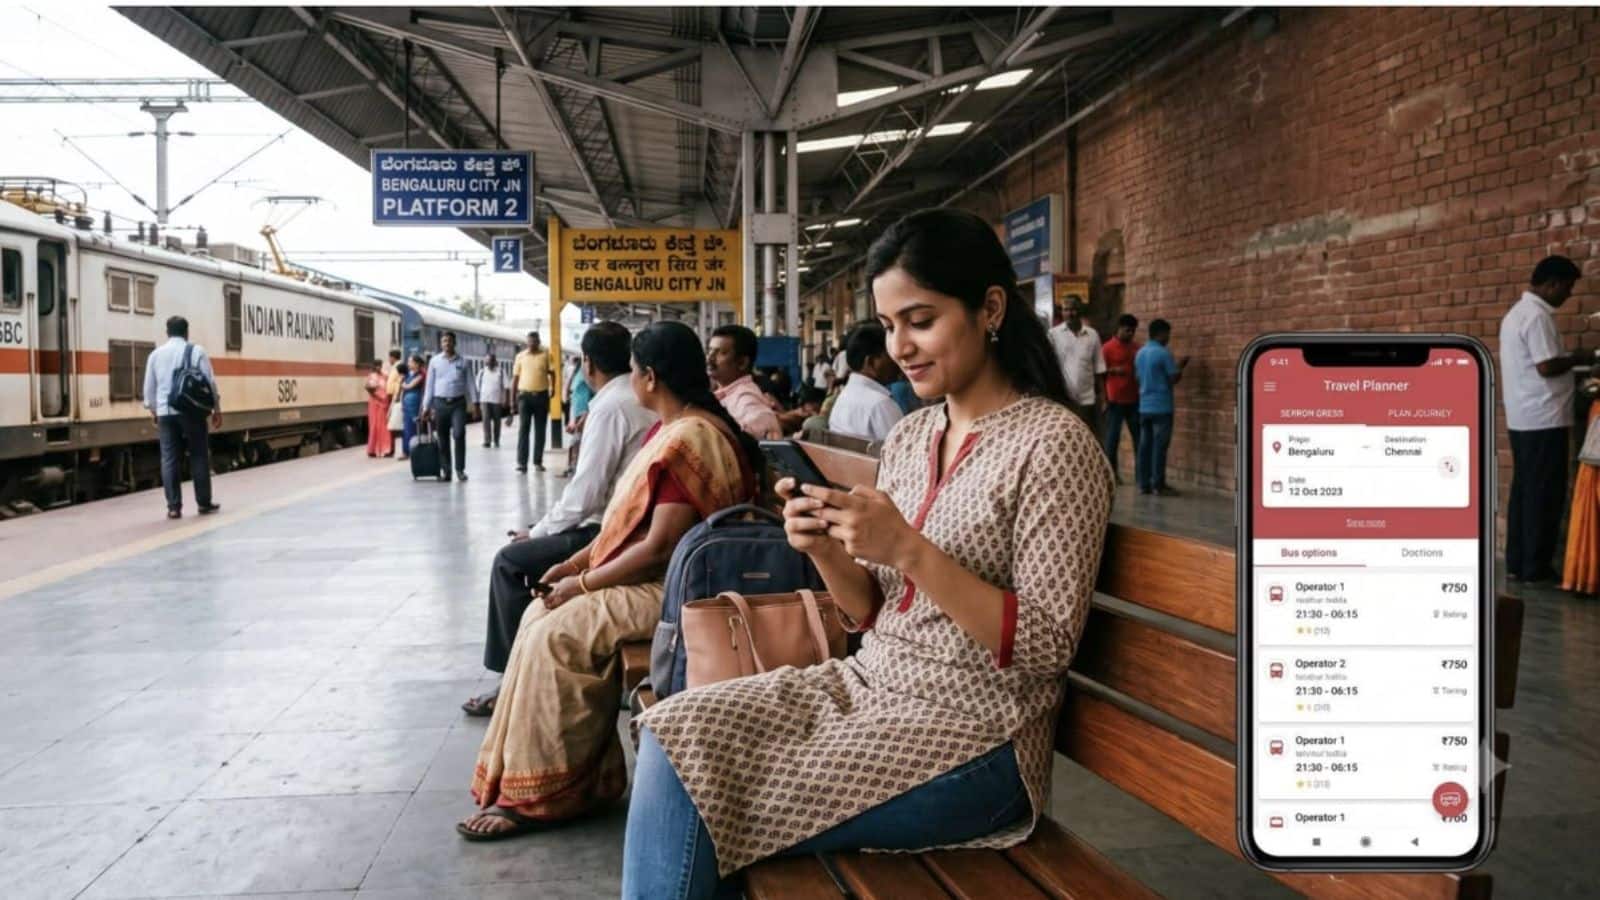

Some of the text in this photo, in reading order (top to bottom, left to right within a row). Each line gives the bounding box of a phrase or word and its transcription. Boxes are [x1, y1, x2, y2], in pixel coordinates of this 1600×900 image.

[382, 178, 521, 192] BENGALURU CITY JN
[383, 198, 518, 216] PLATFORM 2
[500, 241, 514, 251] FF
[502, 252, 513, 269] 2
[574, 277, 726, 291] BENGALURU CITY JN
[243, 304, 335, 343] INDIAN RAILWAYS
[1270, 358, 1289, 367] 9:41
[1324, 379, 1409, 392] Travel Planner
[278, 379, 298, 403] SBC
[1388, 409, 1453, 418] PLAN JOURNEY
[1288, 447, 1335, 458] Bengaluru
[1384, 447, 1422, 456] Chennai
[1289, 487, 1343, 496] 12 Oct 2023
[1281, 548, 1338, 559] Bus options
[1295, 582, 1344, 592] Operator 1
[1441, 583, 1468, 592] ₹750
[1296, 609, 1322, 618] 21:30
[1295, 659, 1346, 669] Operator 2
[1441, 660, 1468, 669] ₹750
[1296, 686, 1322, 695] 21:30
[1331, 686, 1358, 695] 06:15
[1295, 736, 1344, 746] Operator 1
[1441, 737, 1468, 746] ₹750
[1296, 763, 1322, 772] 21:30
[1295, 812, 1344, 822] Operator 1
